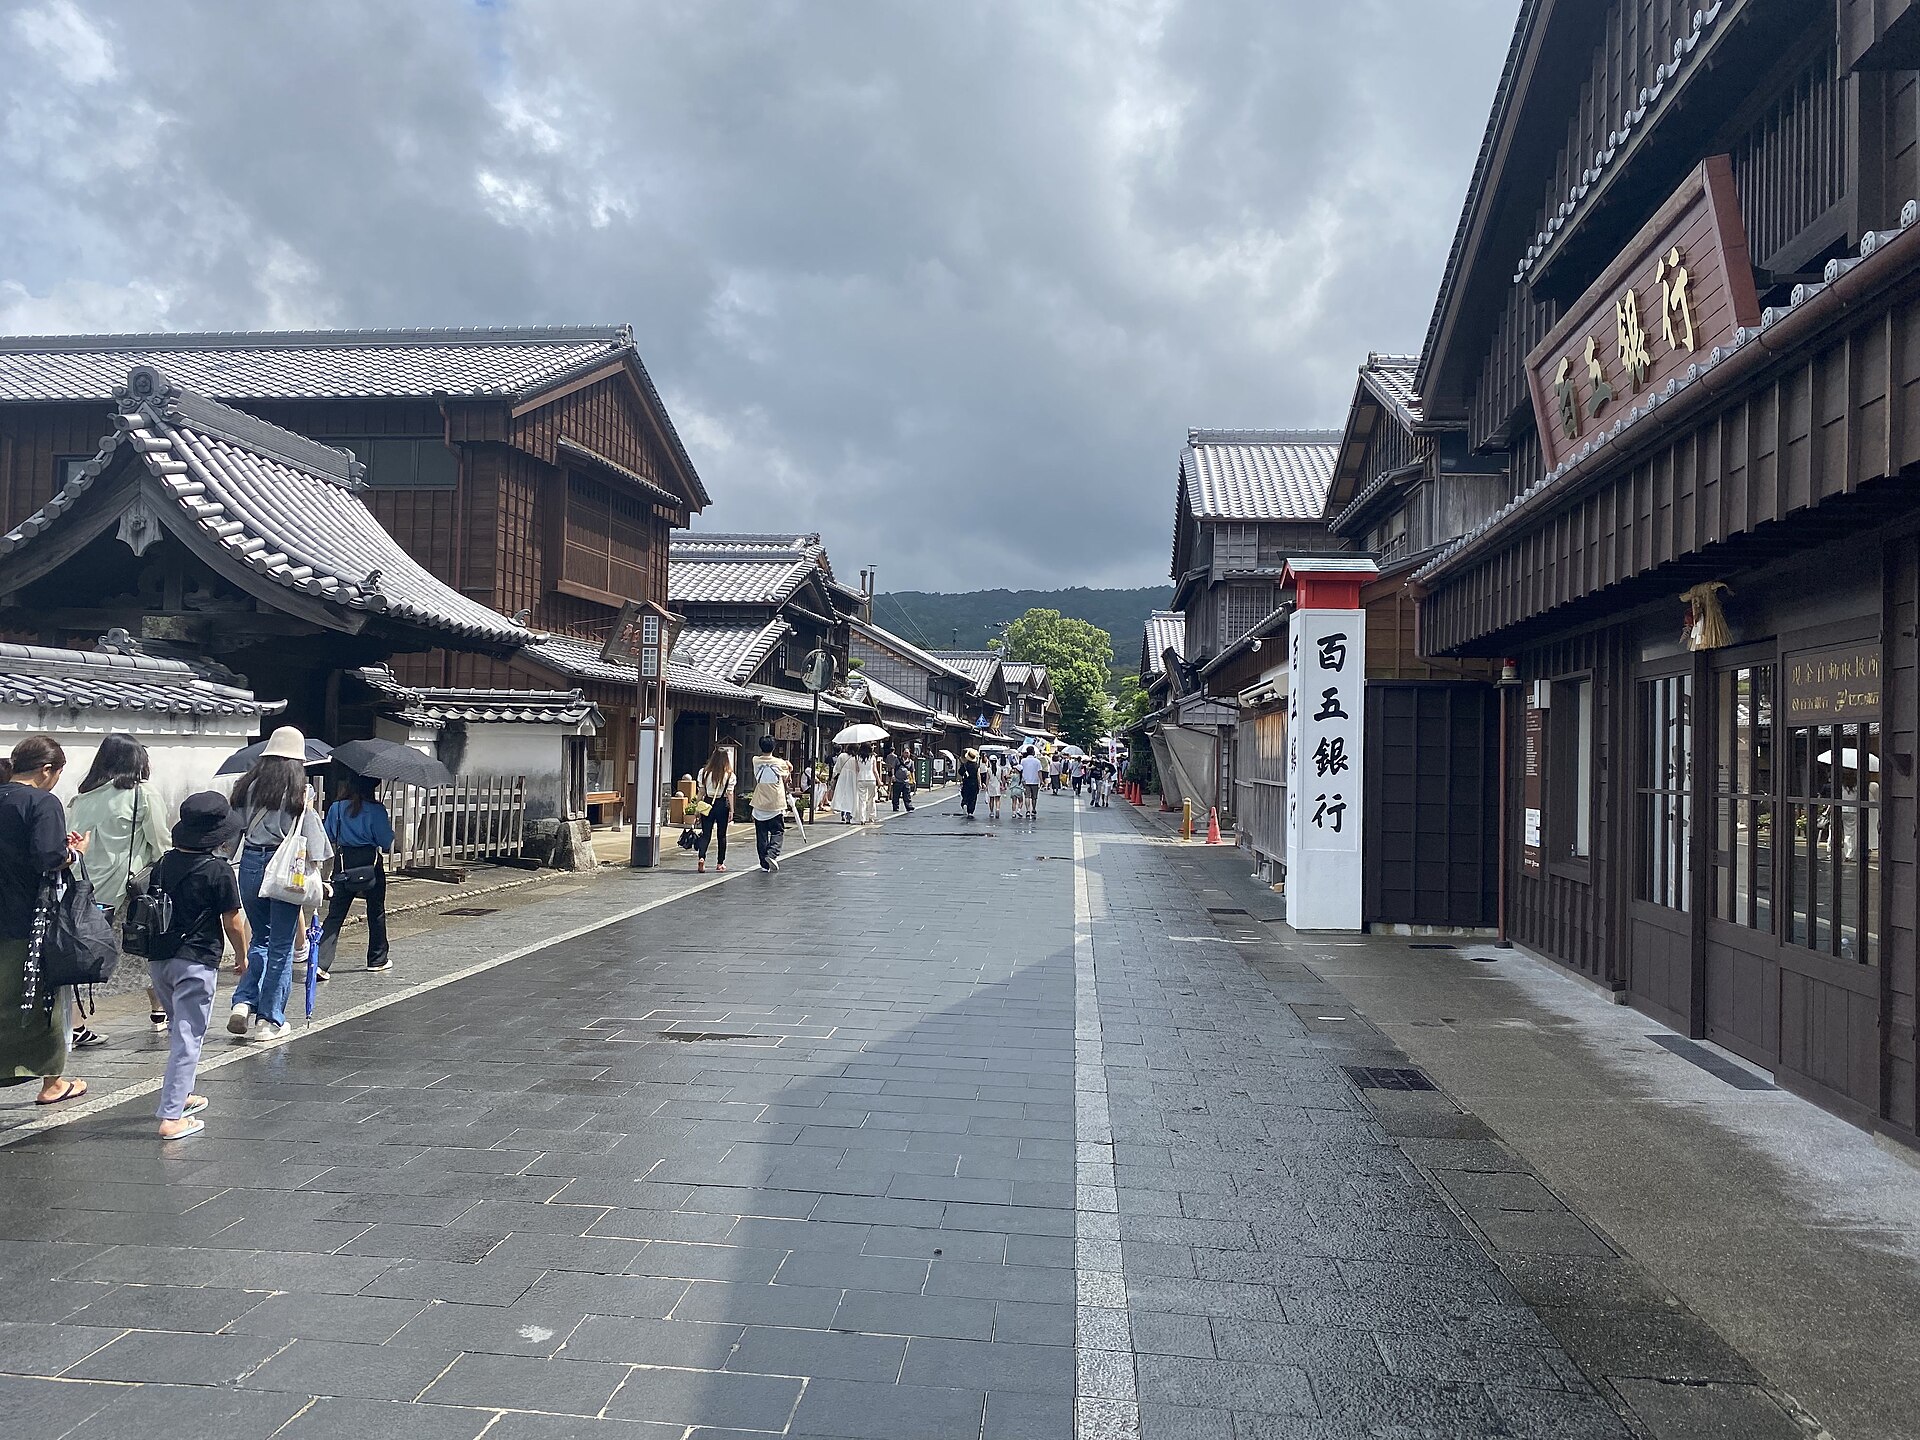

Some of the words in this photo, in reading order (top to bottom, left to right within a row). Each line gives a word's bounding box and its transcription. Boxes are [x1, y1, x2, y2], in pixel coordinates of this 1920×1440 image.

[1555, 246, 1695, 439] 百五銀行
[1311, 632, 1349, 833] 百五銀行
